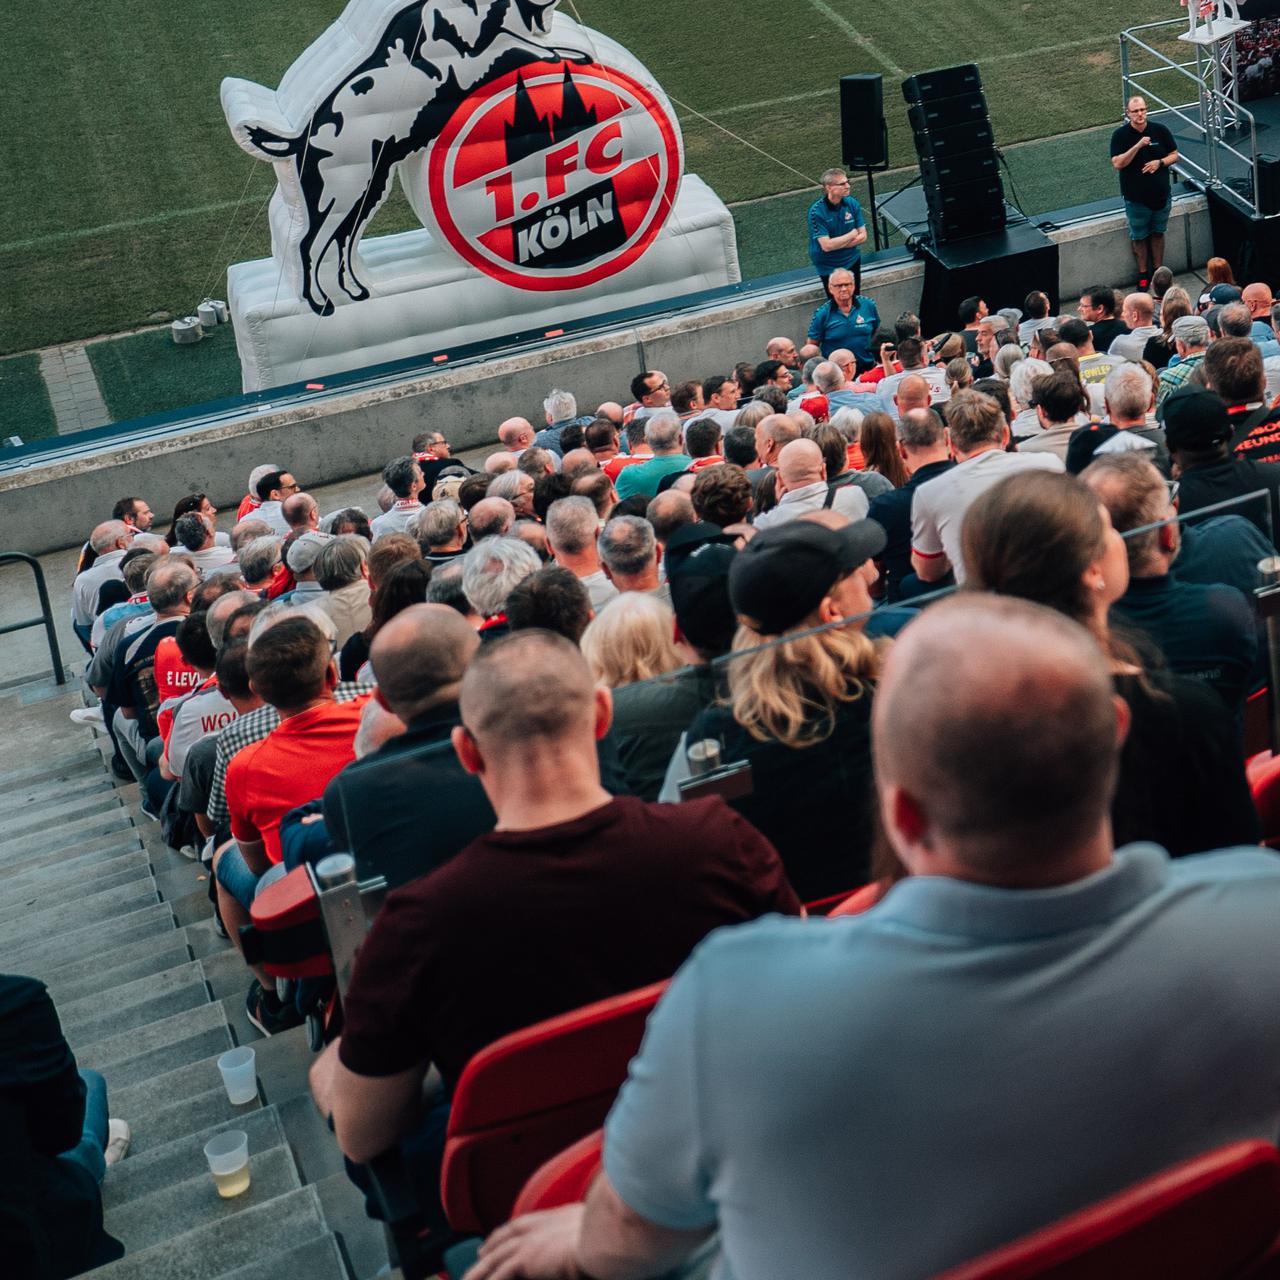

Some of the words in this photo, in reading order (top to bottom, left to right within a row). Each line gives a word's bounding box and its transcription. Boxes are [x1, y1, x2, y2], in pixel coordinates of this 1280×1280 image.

[485, 121, 624, 223] 1.FC
[517, 190, 615, 264] KÖLN
[201, 711, 238, 733] WO
